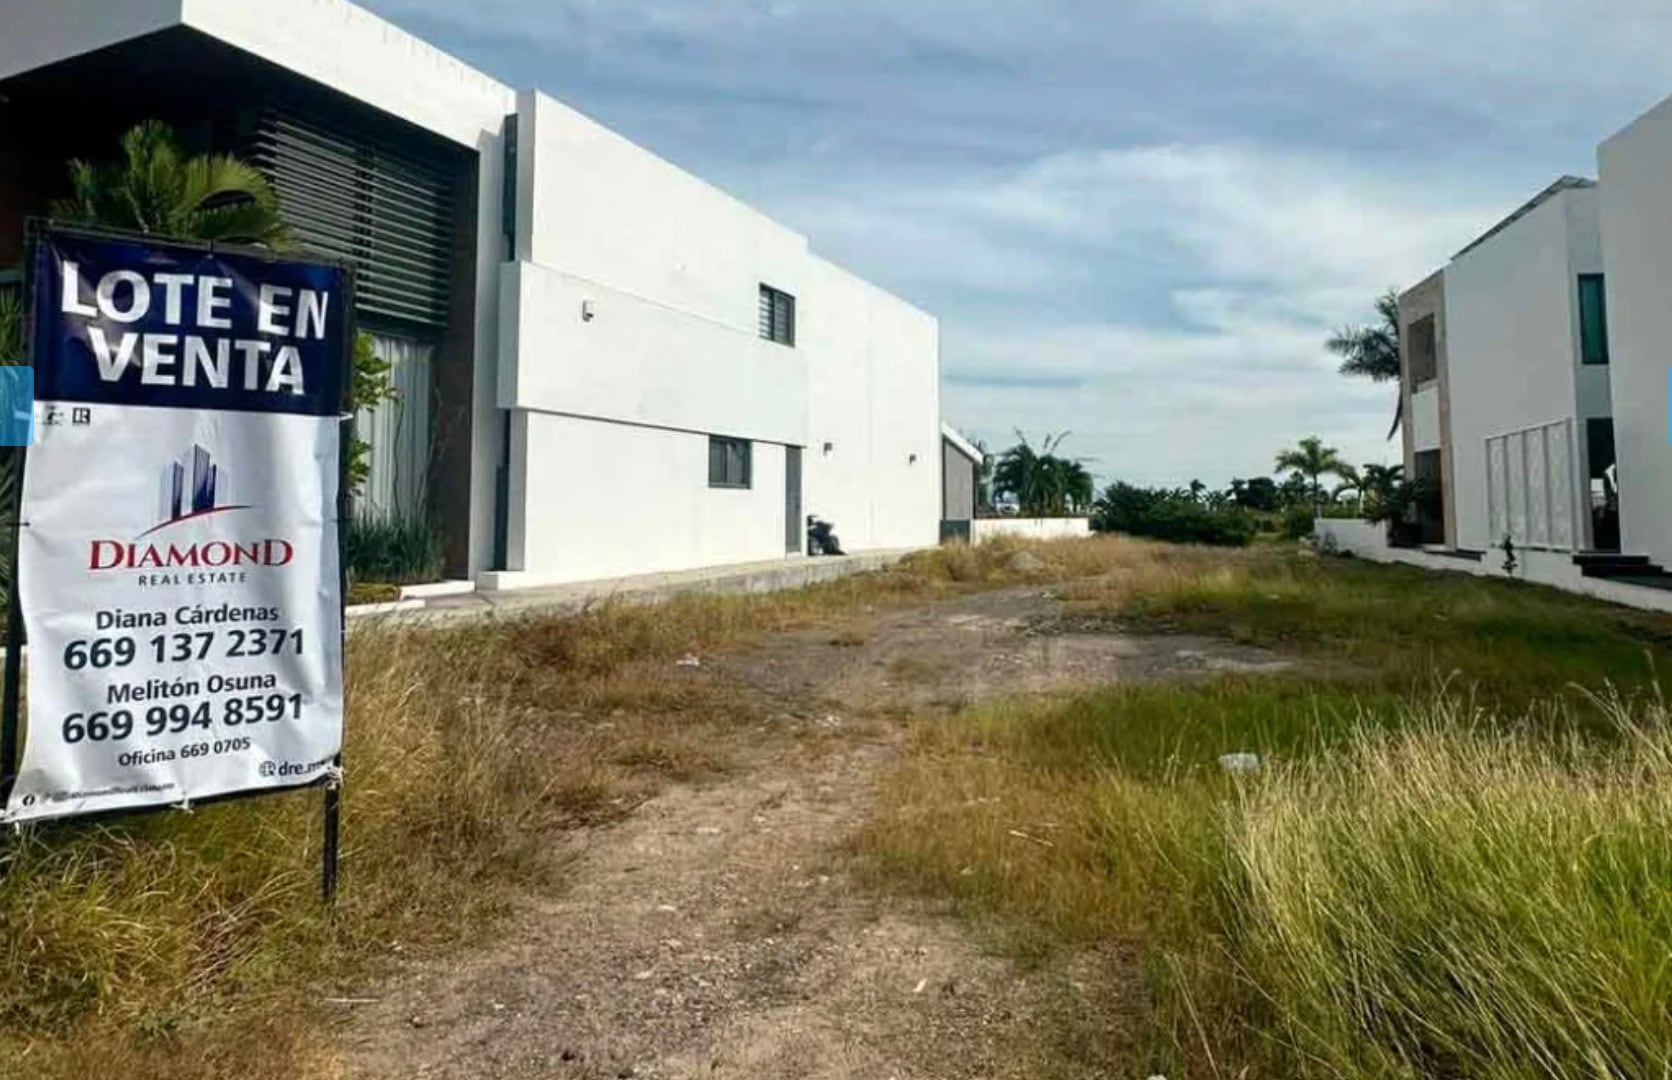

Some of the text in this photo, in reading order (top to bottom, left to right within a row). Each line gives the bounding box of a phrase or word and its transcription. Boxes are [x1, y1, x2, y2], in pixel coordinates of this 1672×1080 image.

[61, 260, 329, 340] LOTE EN
[88, 326, 305, 395] VENTA
[89, 539, 294, 570] DIAMOND
[138, 572, 248, 587] REAL ESTATE
[96, 603, 279, 630] Diana Cárdenas
[63, 628, 304, 670] 669 137 2371
[107, 673, 276, 704] Melitón Osuna
[62, 693, 303, 743] 669 994 8591
[118, 736, 251, 766] Oficina 669 0705
